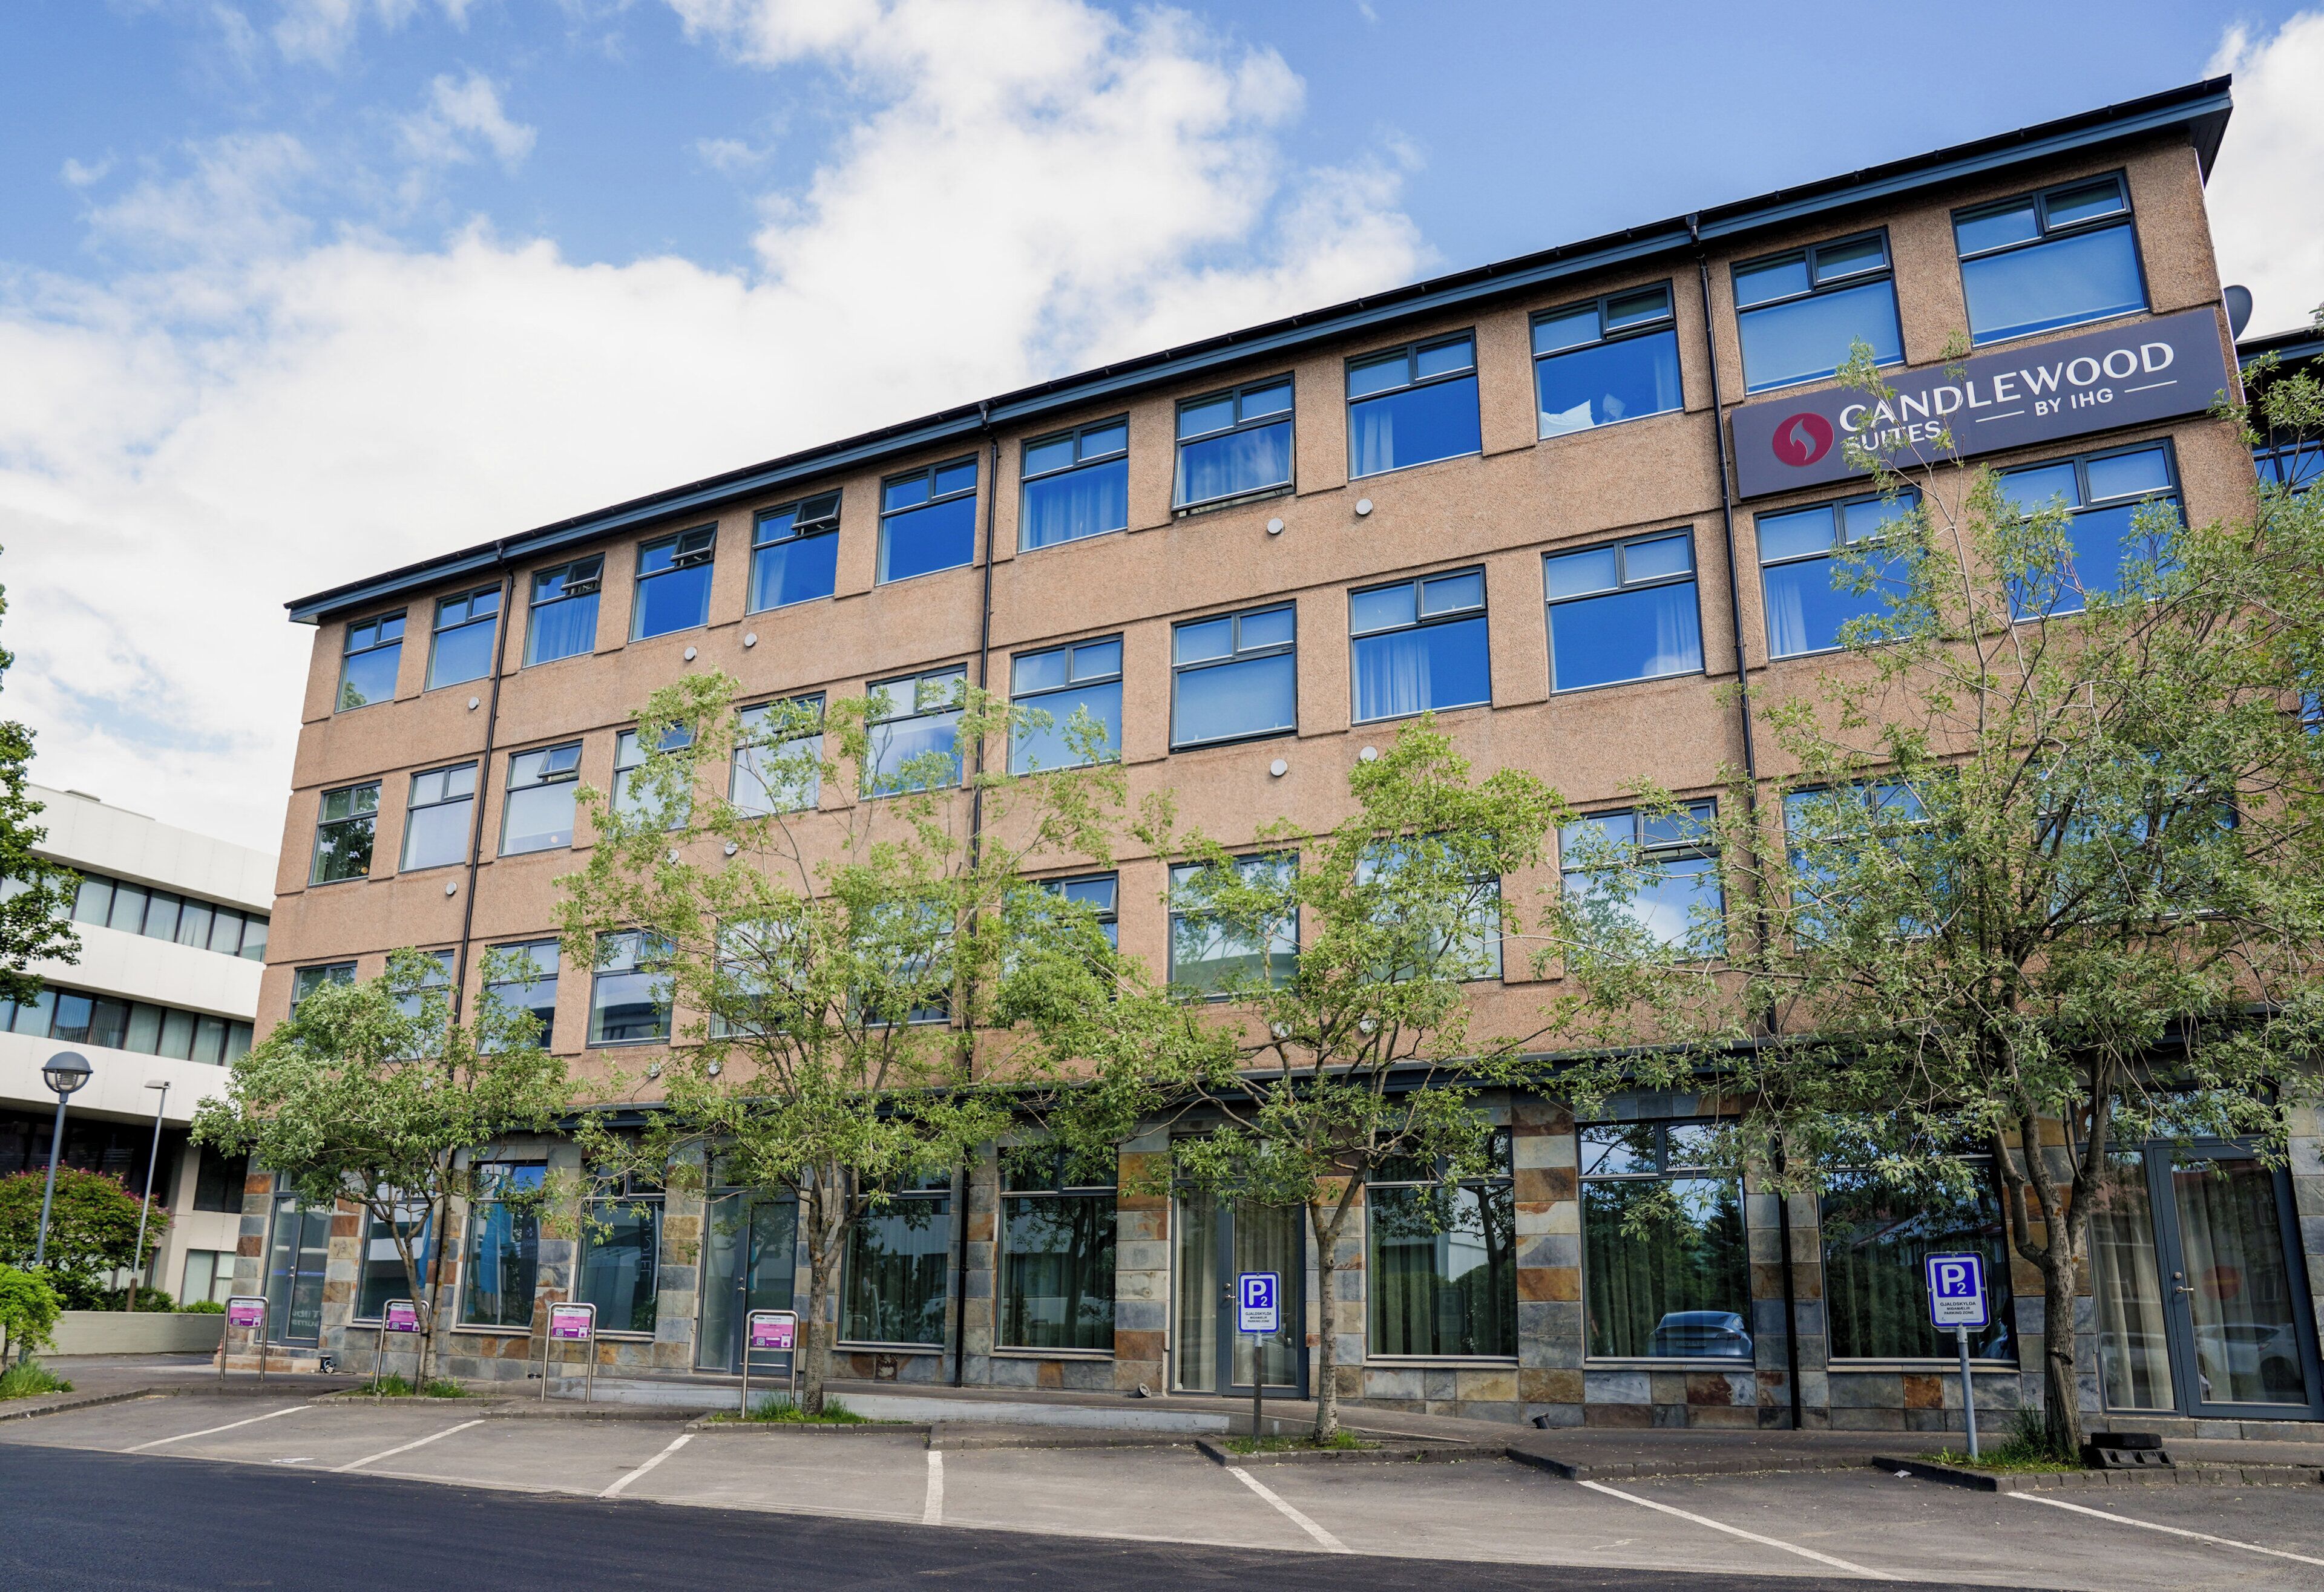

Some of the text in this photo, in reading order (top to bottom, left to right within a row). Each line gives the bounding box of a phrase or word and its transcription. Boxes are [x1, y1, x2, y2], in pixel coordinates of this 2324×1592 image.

[1839, 342, 2174, 432] CANDLEWOOD
[2035, 388, 2113, 416] BY IHG
[1846, 421, 1942, 454] SUITES
